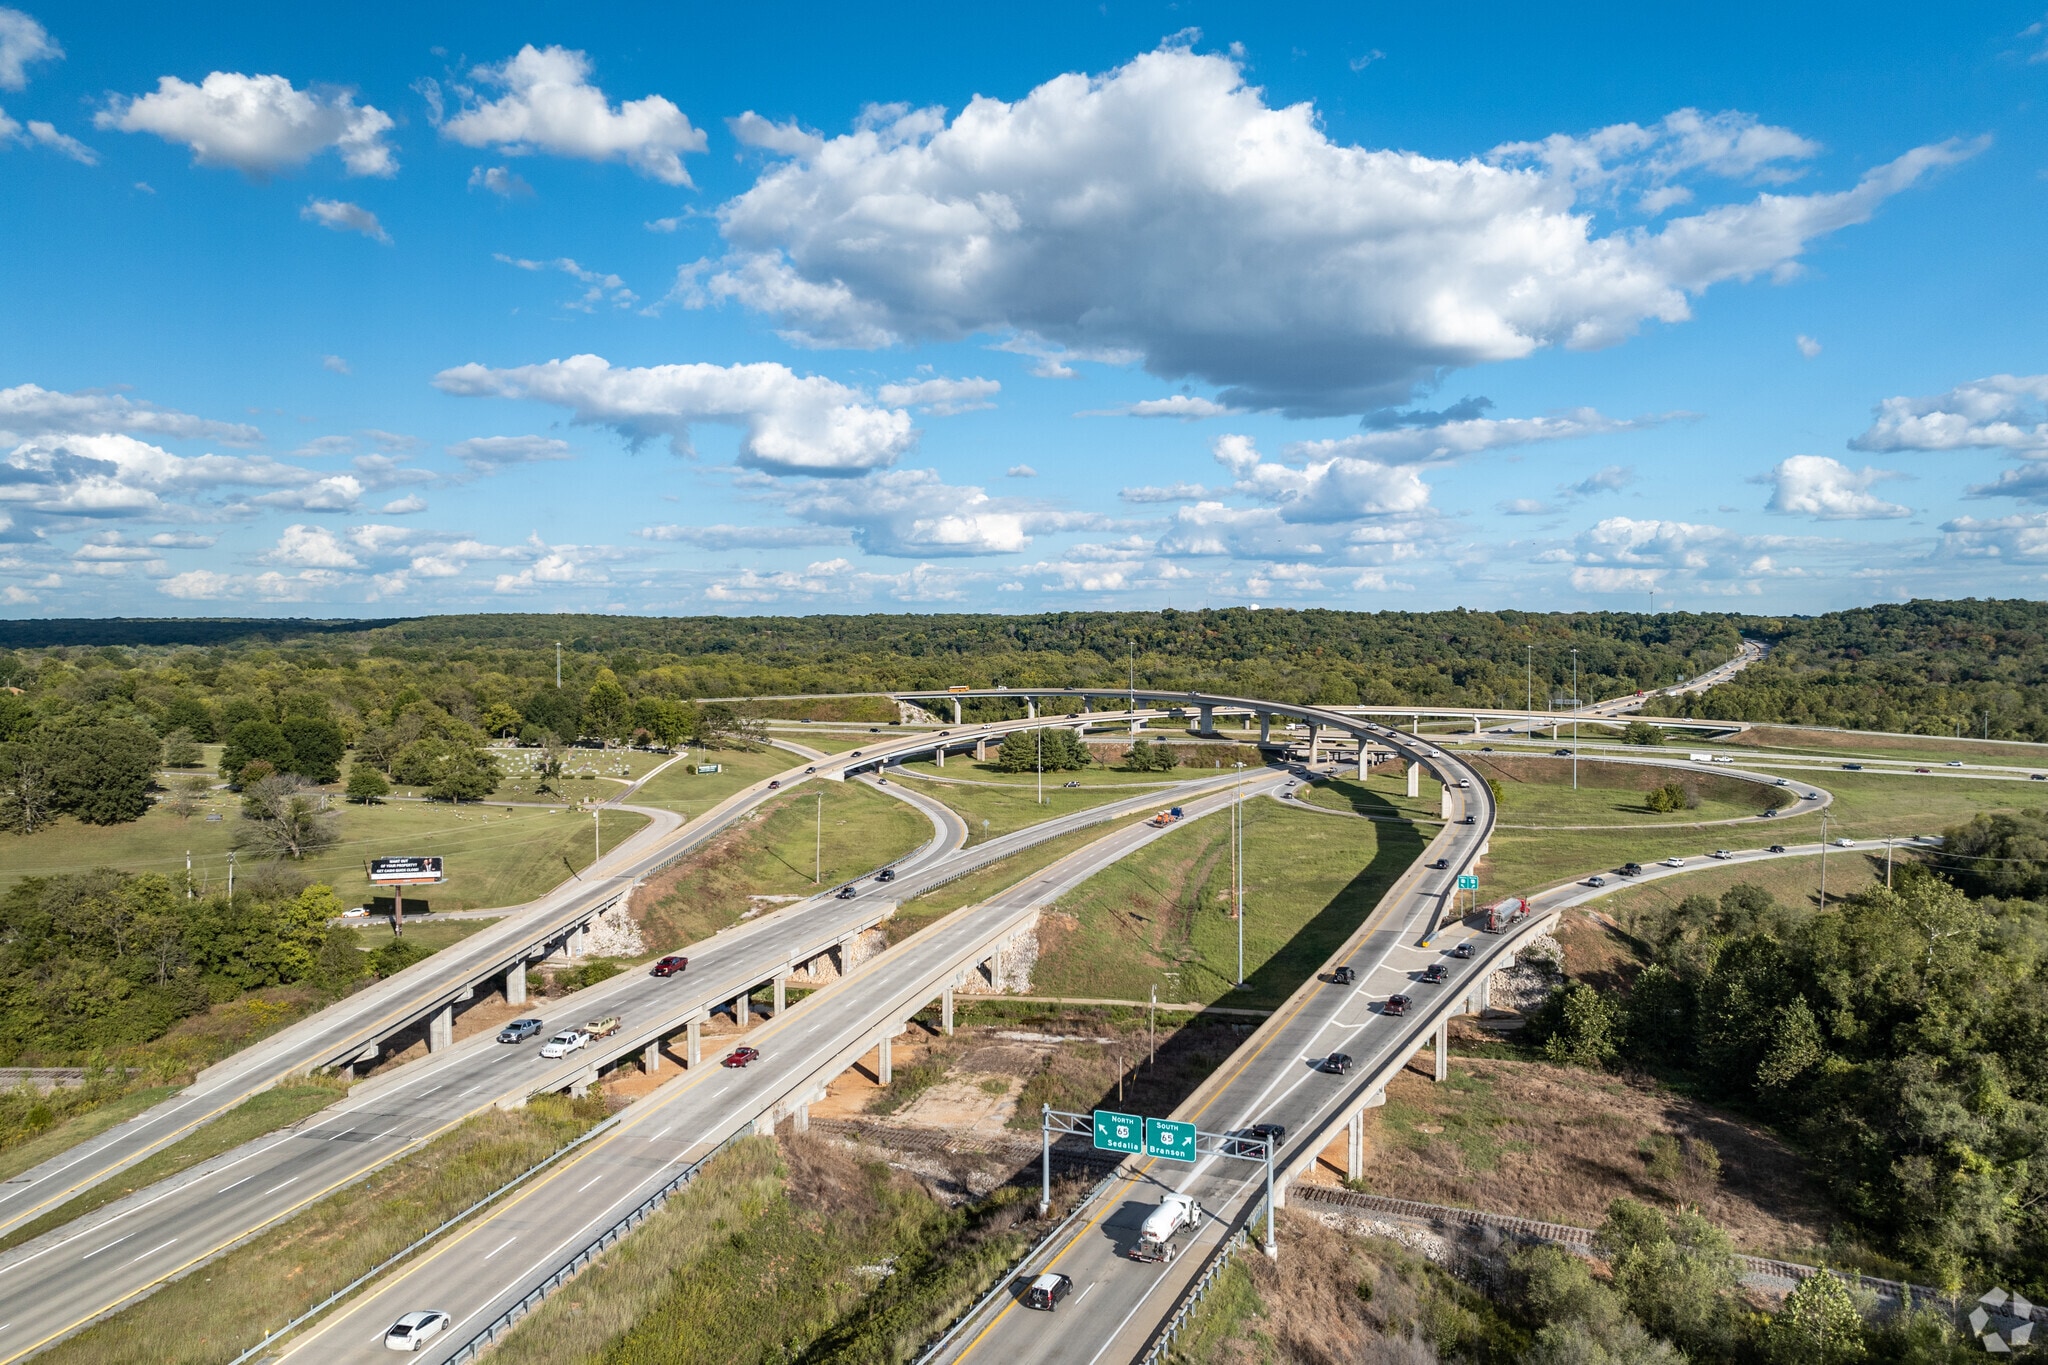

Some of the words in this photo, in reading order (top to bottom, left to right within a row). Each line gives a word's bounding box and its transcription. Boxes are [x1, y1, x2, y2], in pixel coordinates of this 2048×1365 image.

[1111, 1115, 1134, 1125] NORTH
[1156, 1121, 1179, 1131] SOUTH
[1118, 1127, 1128, 1136] 65
[1162, 1134, 1173, 1142] 65
[1107, 1139, 1139, 1150] Sedalia
[1150, 1145, 1186, 1157] Branson
